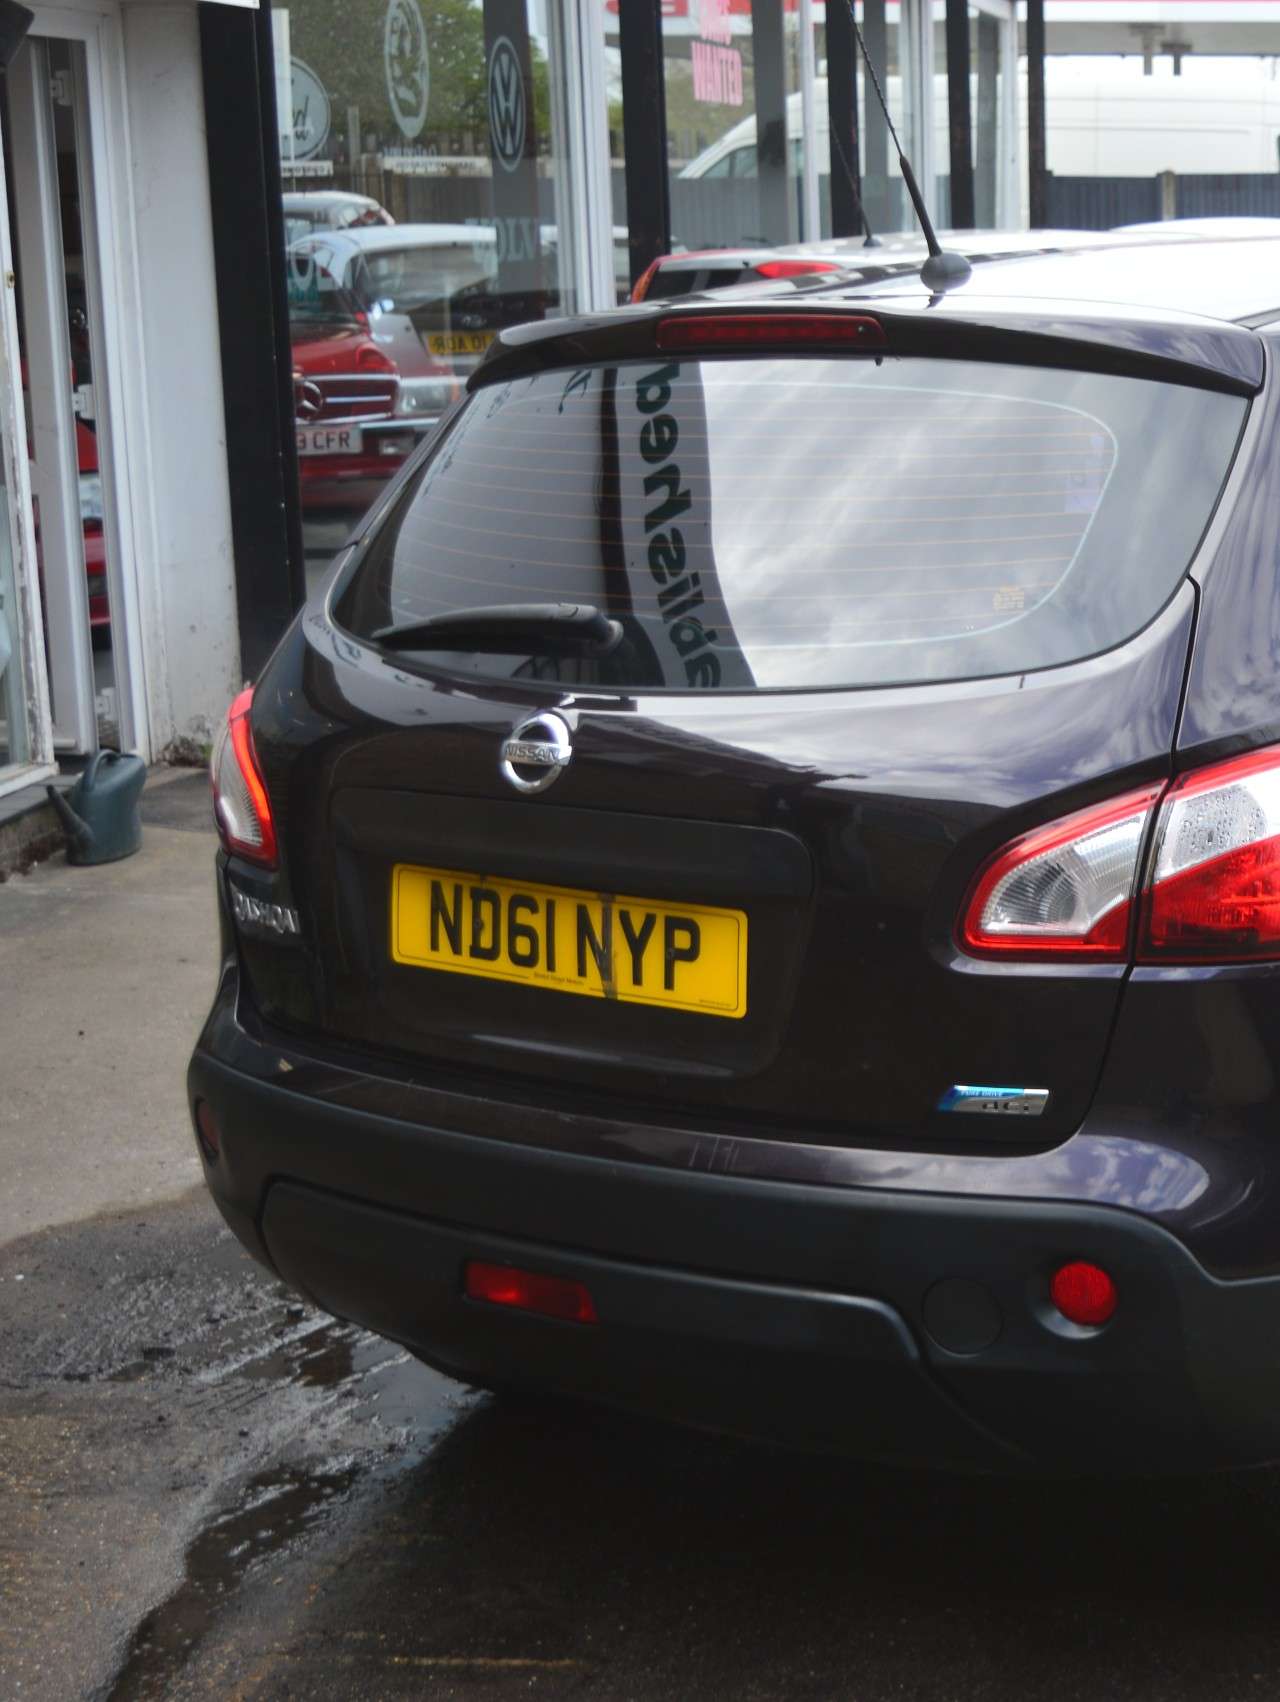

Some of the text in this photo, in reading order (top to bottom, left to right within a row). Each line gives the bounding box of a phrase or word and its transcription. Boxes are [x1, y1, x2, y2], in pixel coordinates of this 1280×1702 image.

[506, 743, 559, 762] NISSAN
[430, 880, 702, 991] ND61 NYP
